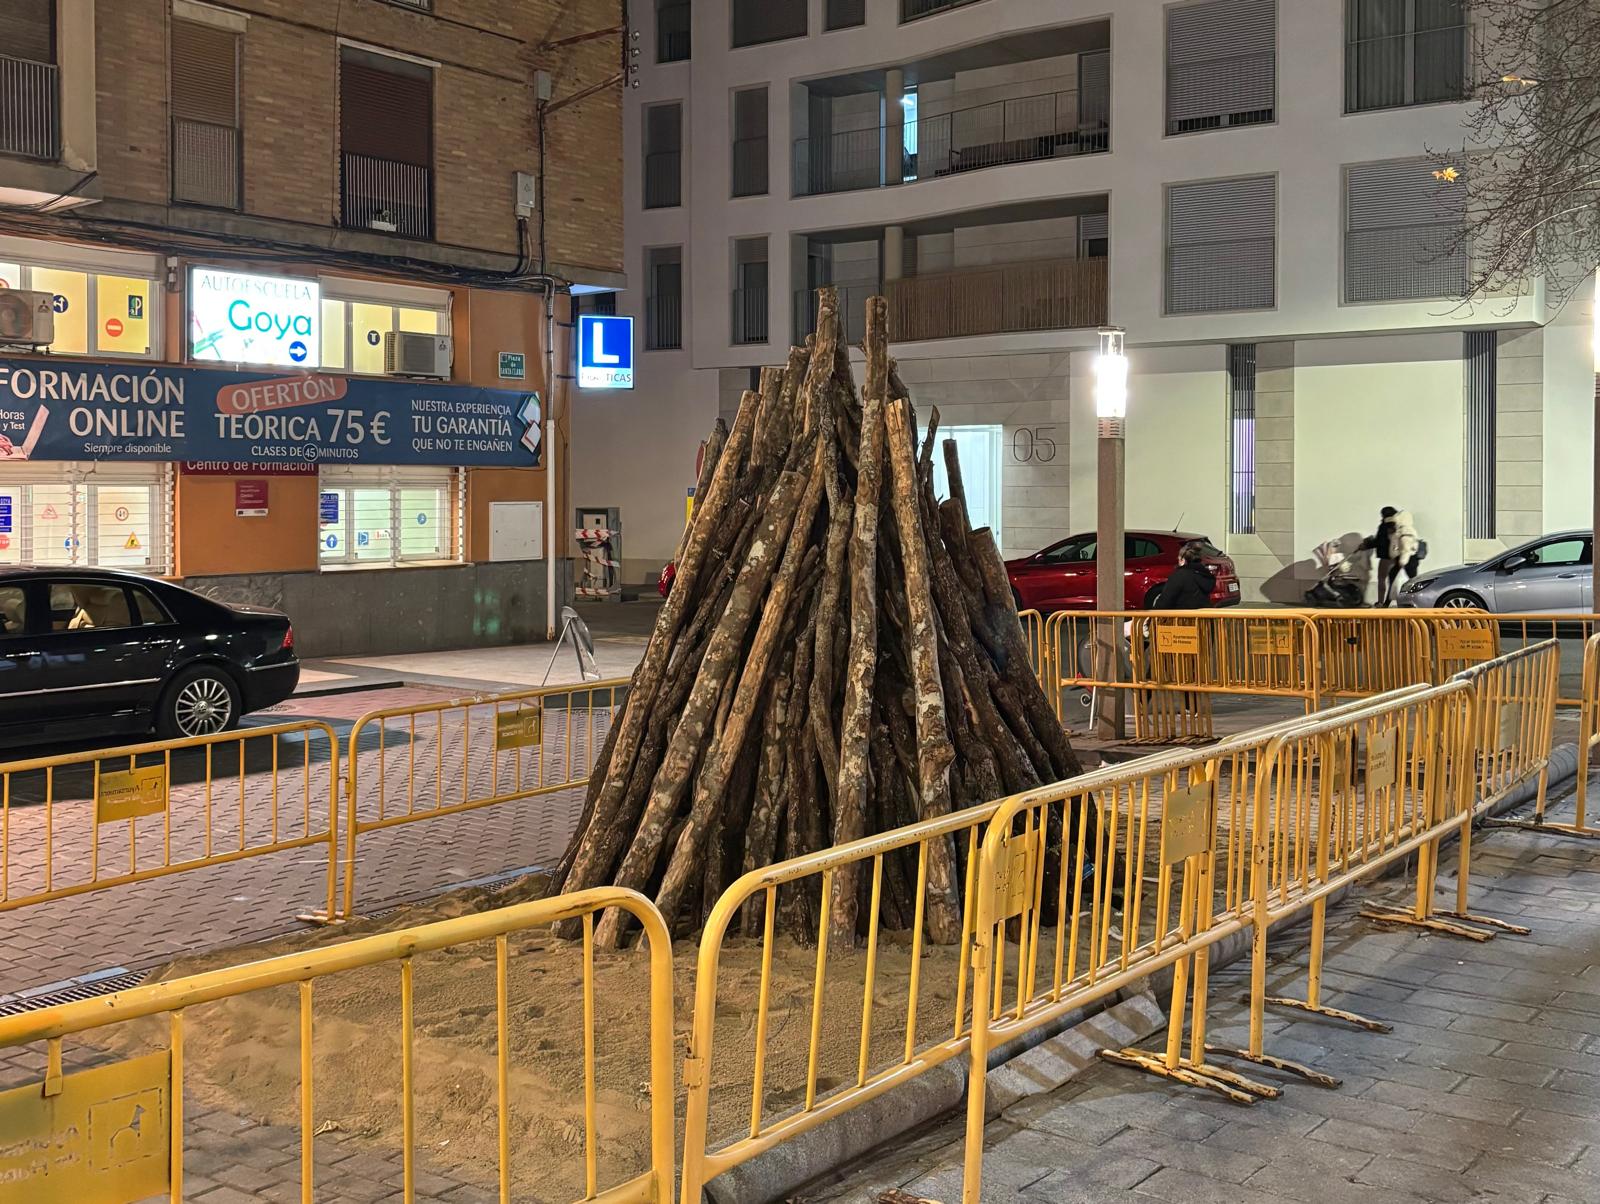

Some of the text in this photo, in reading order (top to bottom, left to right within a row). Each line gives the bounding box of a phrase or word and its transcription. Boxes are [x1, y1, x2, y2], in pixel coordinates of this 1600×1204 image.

[201, 275, 312, 300] AUTOESCUELA
[228, 299, 312, 340] Goya
[593, 322, 620, 363] L
[231, 376, 336, 410] OFERTÓN
[411, 399, 512, 416] NUESTRA EXPERIENCIA
[3, 421, 25, 431] y Test
[69, 407, 186, 438] ONLINE
[214, 409, 322, 442] TEÓRICA
[412, 415, 512, 436] TU GARANTÍA
[84, 442, 172, 455] Siempre disponible
[251, 445, 359, 459] CLASES DE 45 MINUTOS
[412, 438, 513, 452] QUE NO TE ENGAÑEN
[1013, 427, 1056, 462] 05
[186, 461, 230, 470] Centro
[233, 461, 249, 470] de
